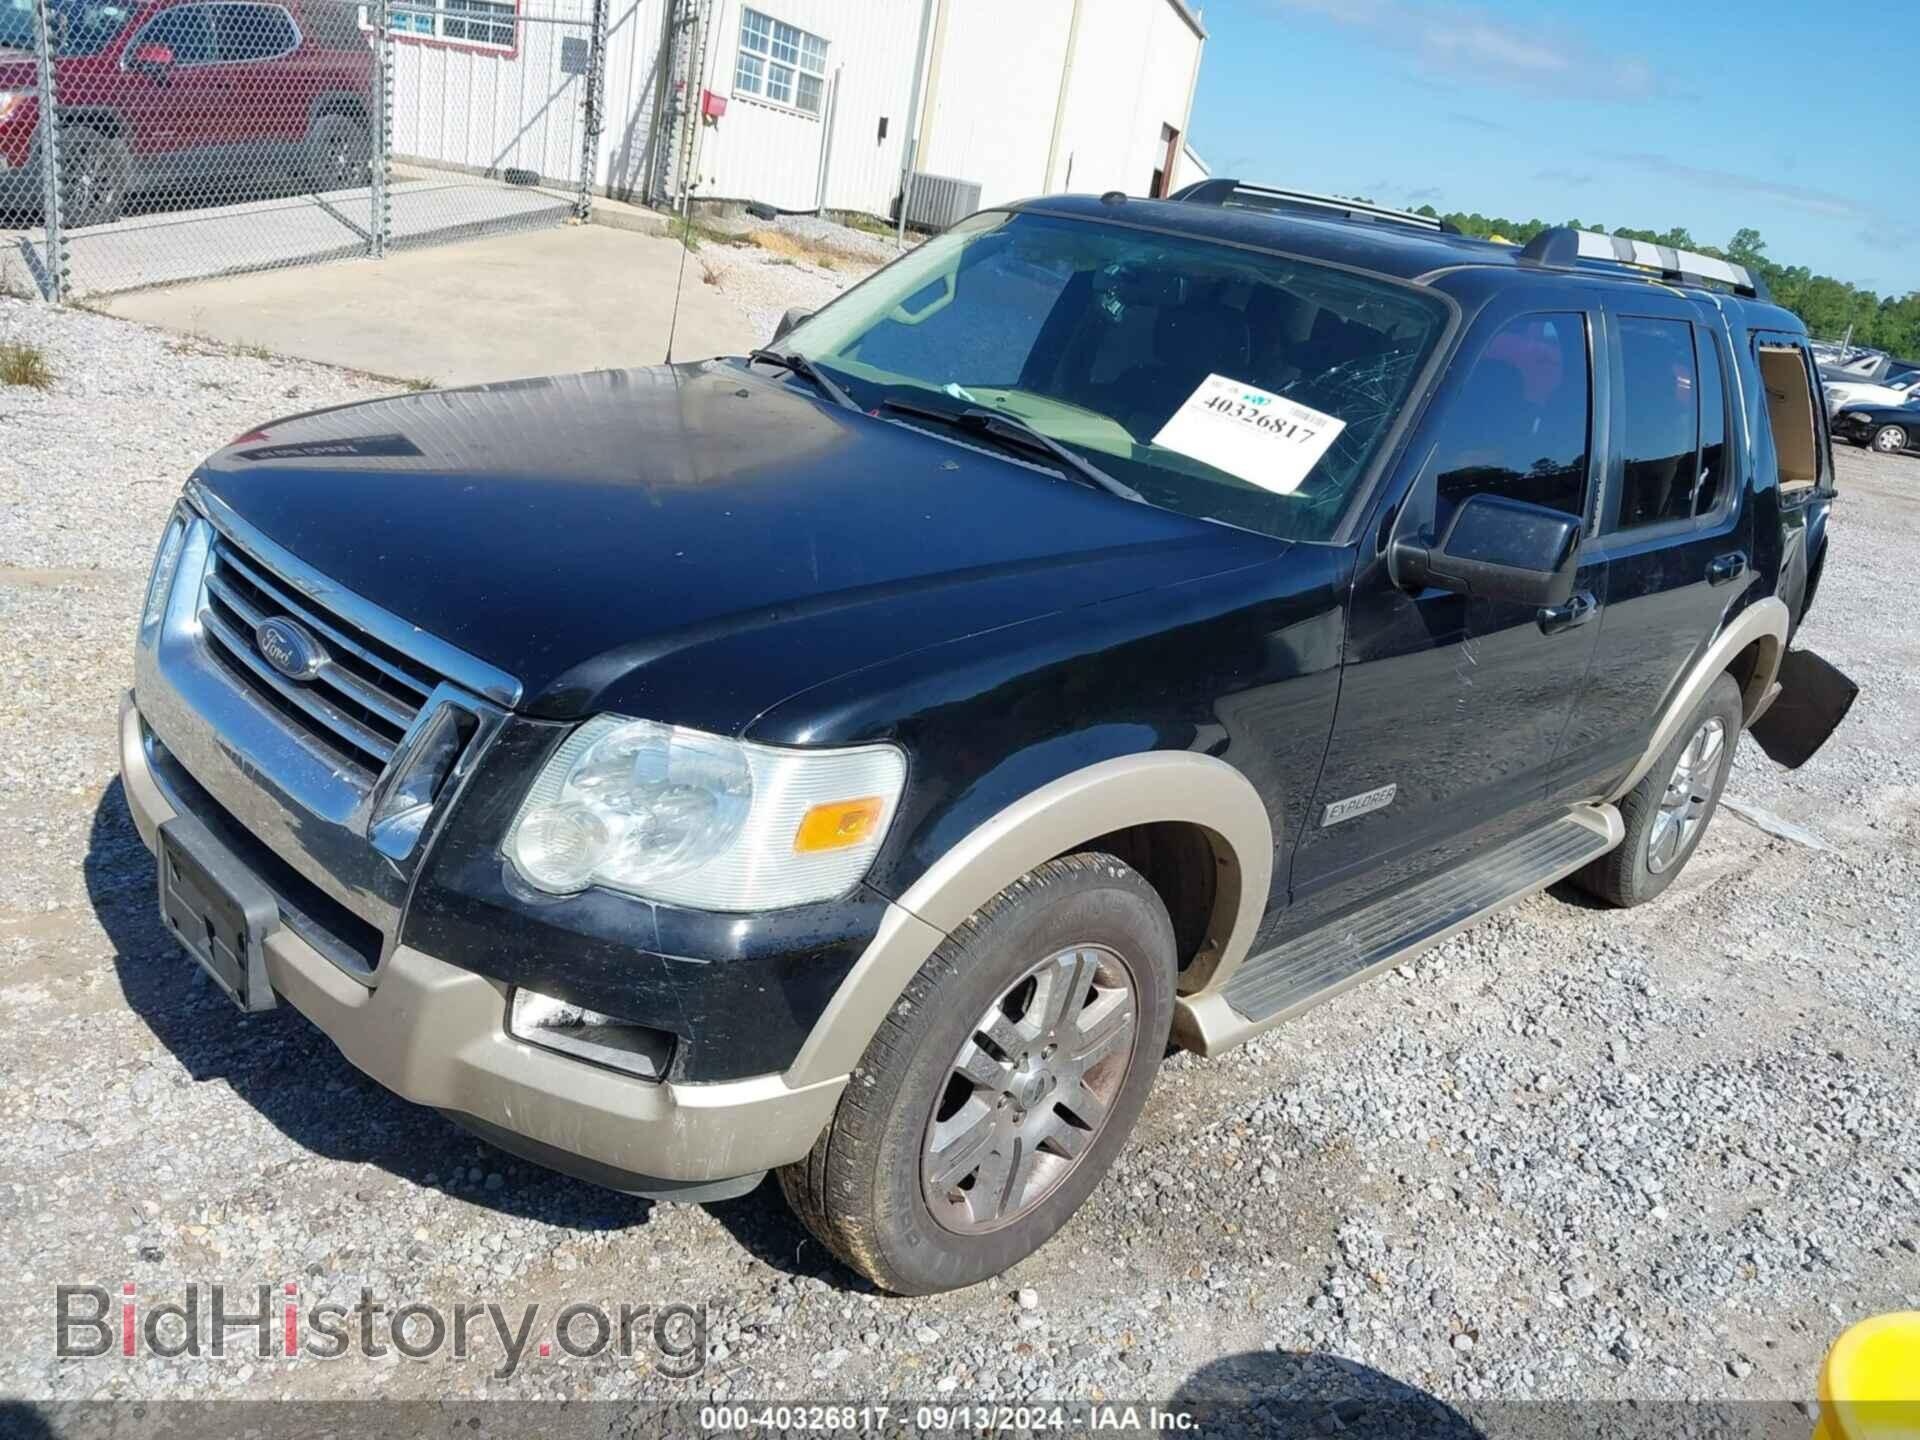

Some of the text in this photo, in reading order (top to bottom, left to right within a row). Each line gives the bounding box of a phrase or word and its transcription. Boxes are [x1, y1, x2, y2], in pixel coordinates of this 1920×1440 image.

[1203, 395, 1316, 444] 40326817
[263, 628, 293, 665] Ford
[1329, 786, 1395, 818] EXPLORER
